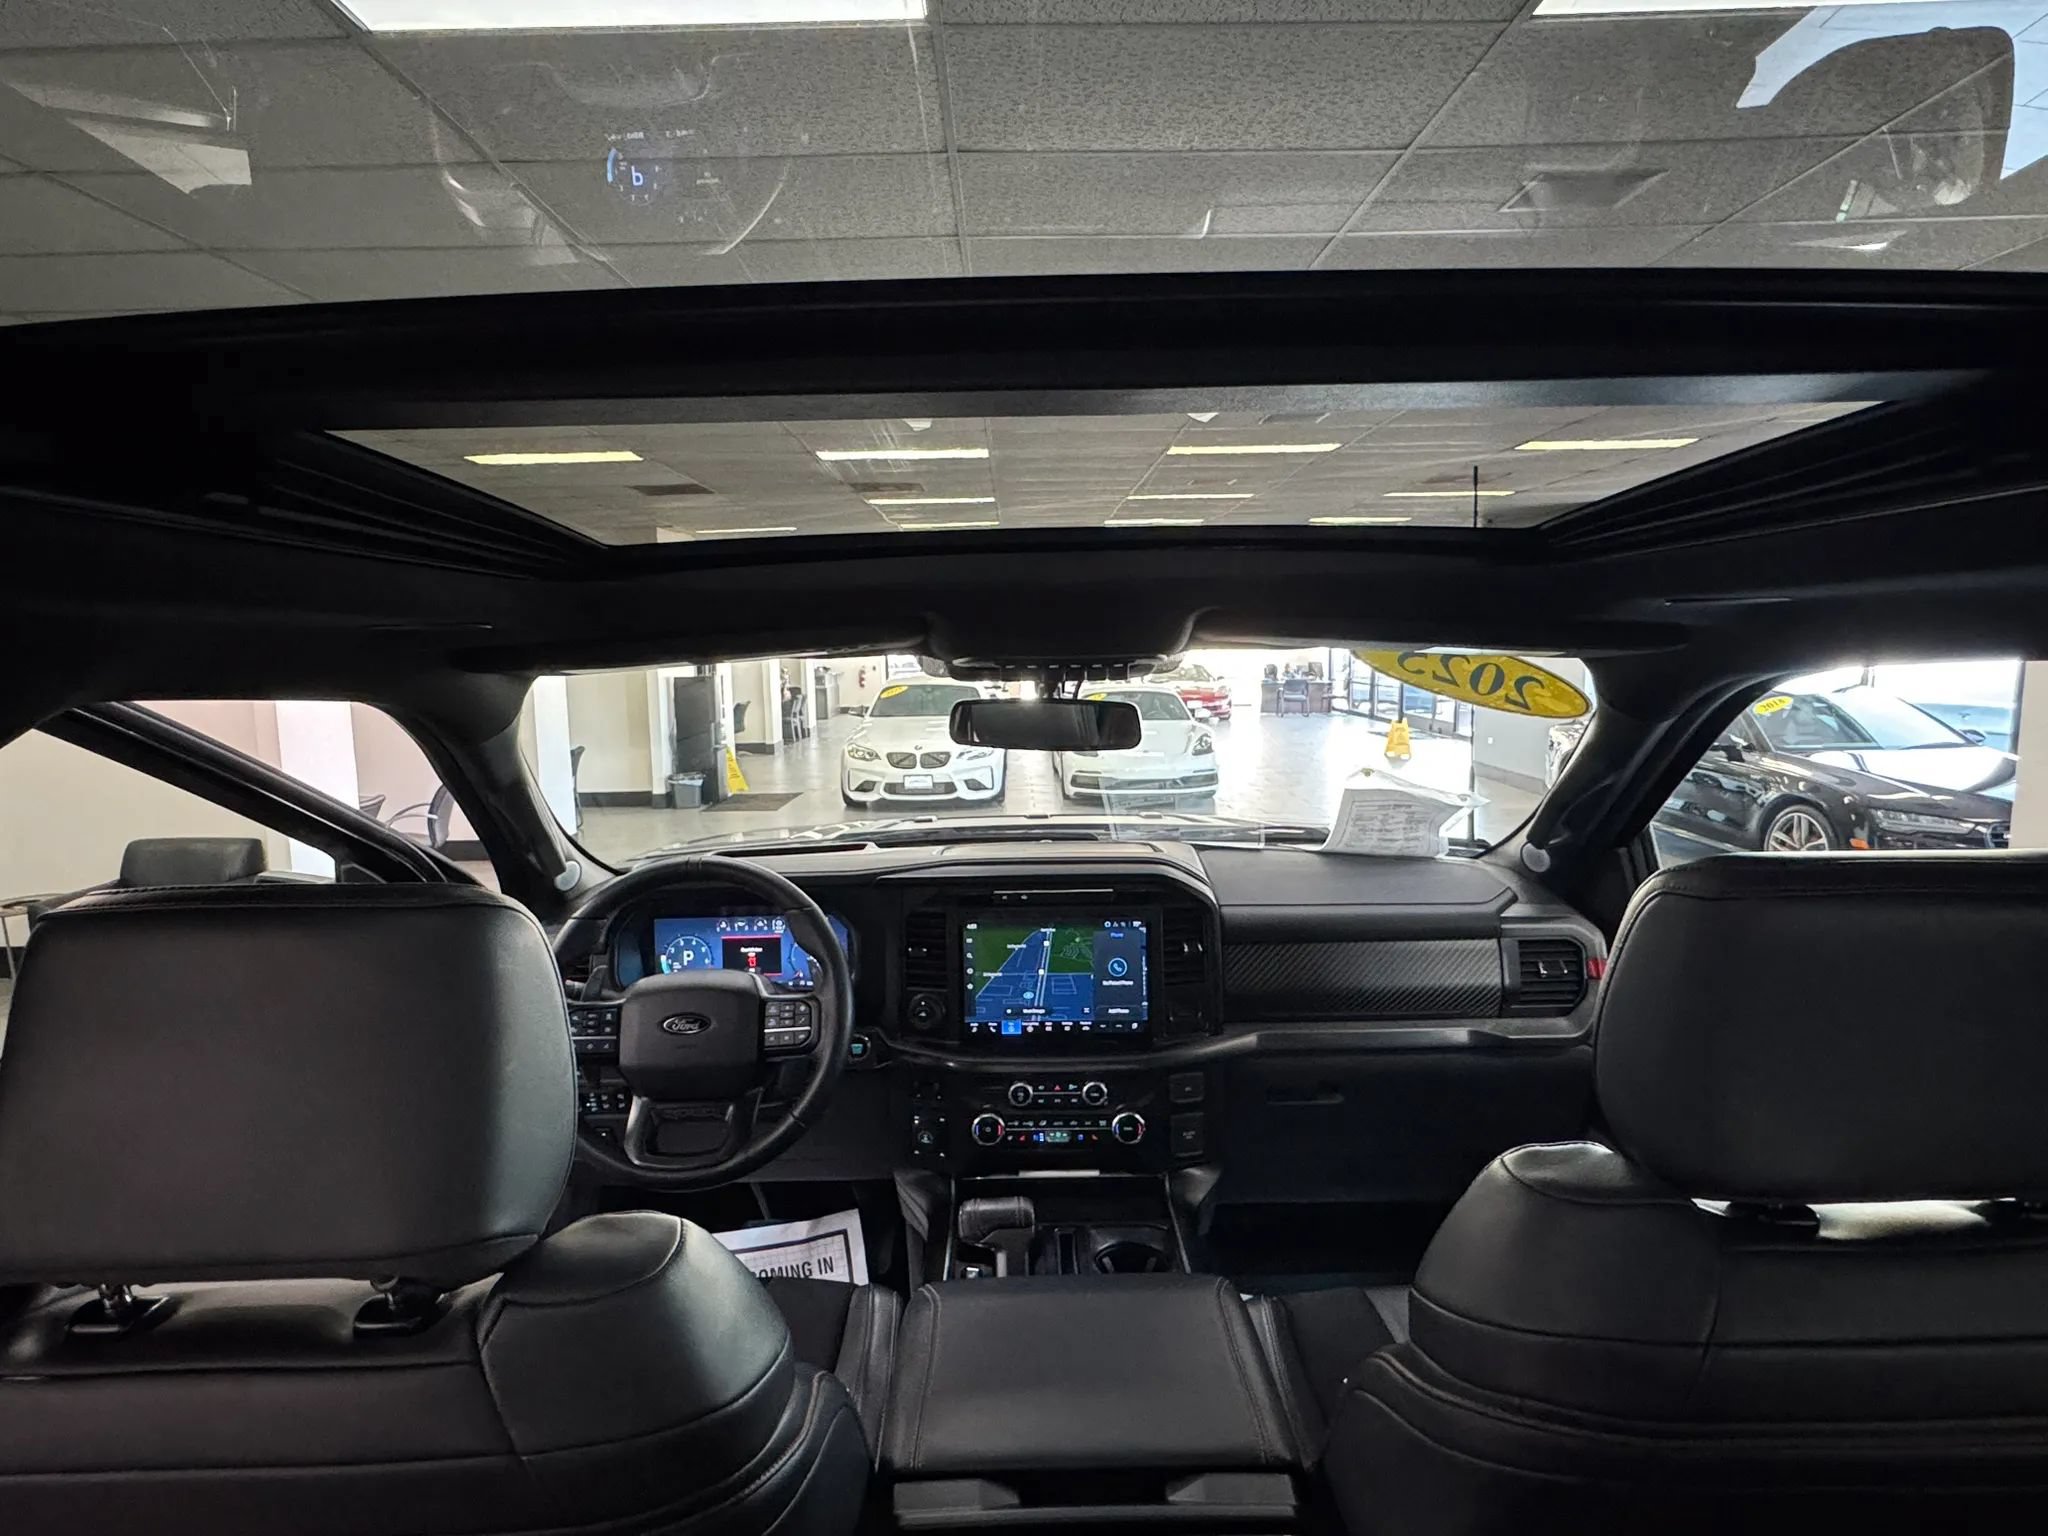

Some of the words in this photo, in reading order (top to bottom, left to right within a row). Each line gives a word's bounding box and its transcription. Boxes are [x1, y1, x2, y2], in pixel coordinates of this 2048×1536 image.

[683, 950, 695, 966] P
[672, 1018, 701, 1031] Ford
[755, 1261, 813, 1278] OMING
[818, 1256, 834, 1275] IN
